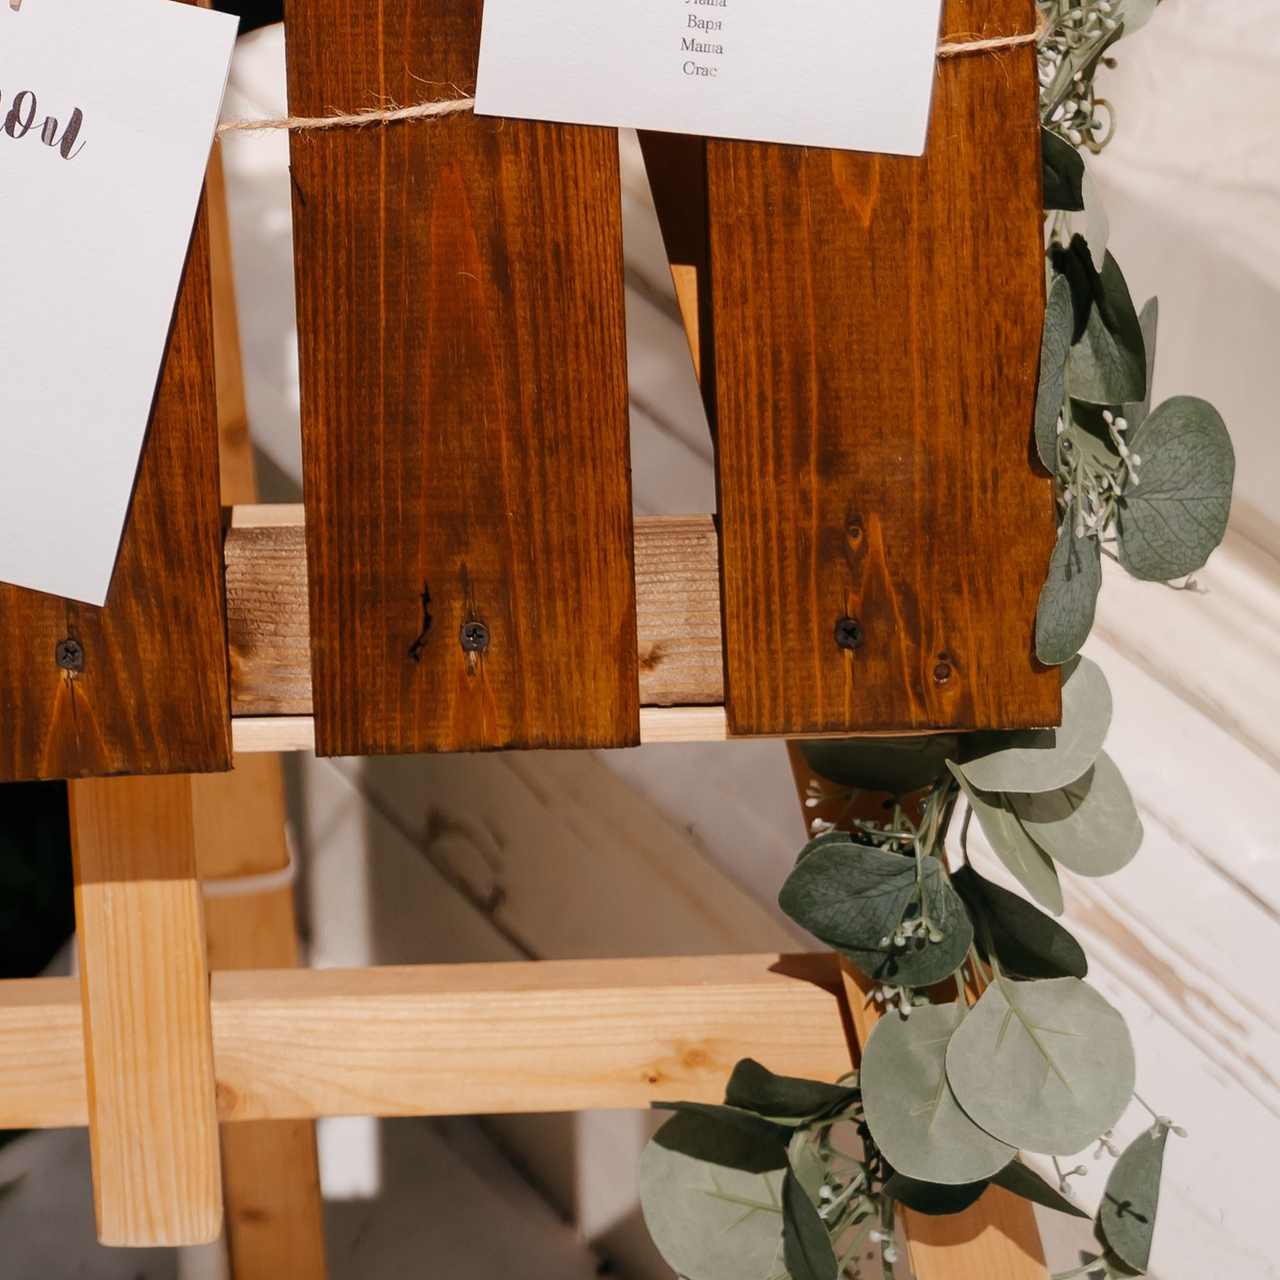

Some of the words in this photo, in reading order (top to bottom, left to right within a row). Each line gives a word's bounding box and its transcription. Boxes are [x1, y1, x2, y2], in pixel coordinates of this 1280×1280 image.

[687, 13, 723, 34] Варя
[680, 37, 724, 55] Маша
[682, 61, 718, 77] Стас
